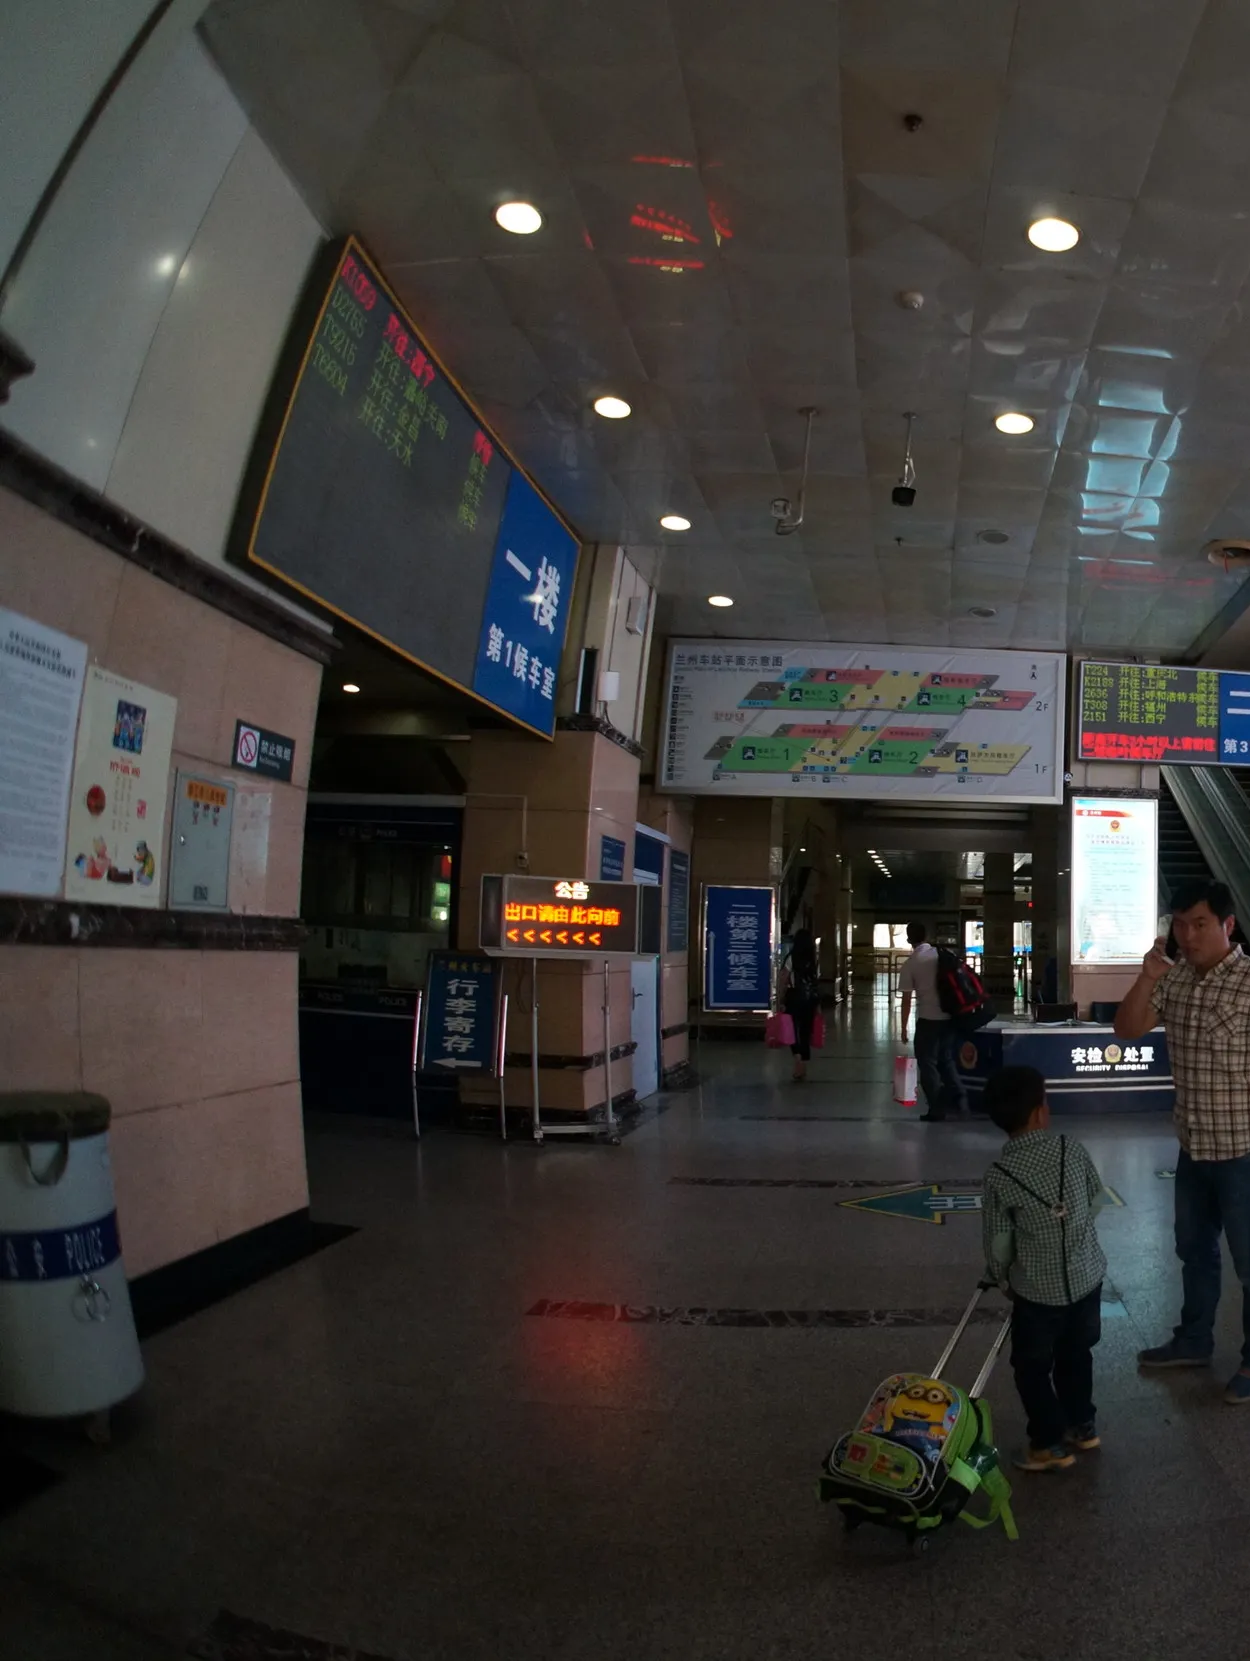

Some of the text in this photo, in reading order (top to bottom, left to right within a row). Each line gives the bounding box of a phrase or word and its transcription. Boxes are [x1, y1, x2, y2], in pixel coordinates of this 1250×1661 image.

[506, 548, 561, 634] 一楼
[486, 622, 556, 700] 第1候车室
[675, 654, 783, 667] 兰州车站平面示意图
[1084, 665, 1108, 676] T224
[829, 689, 838, 703] 3
[1084, 688, 1108, 699] 2636
[957, 694, 966, 707] 4
[1036, 701, 1049, 711] 2F
[1084, 699, 1108, 711] T308
[783, 748, 790, 761] 1
[908, 751, 919, 764] 2
[1034, 764, 1047, 774] 1F
[555, 881, 590, 900] 公告
[505, 903, 621, 926] 出口请由此向前
[726, 904, 760, 991] 二楼第三候车室
[441, 978, 480, 1053] 行李寄存
[1071, 1046, 1154, 1064] 安检 处置
[1075, 1064, 1111, 1072] SECURITY
[64, 1226, 105, 1273] POLICE
